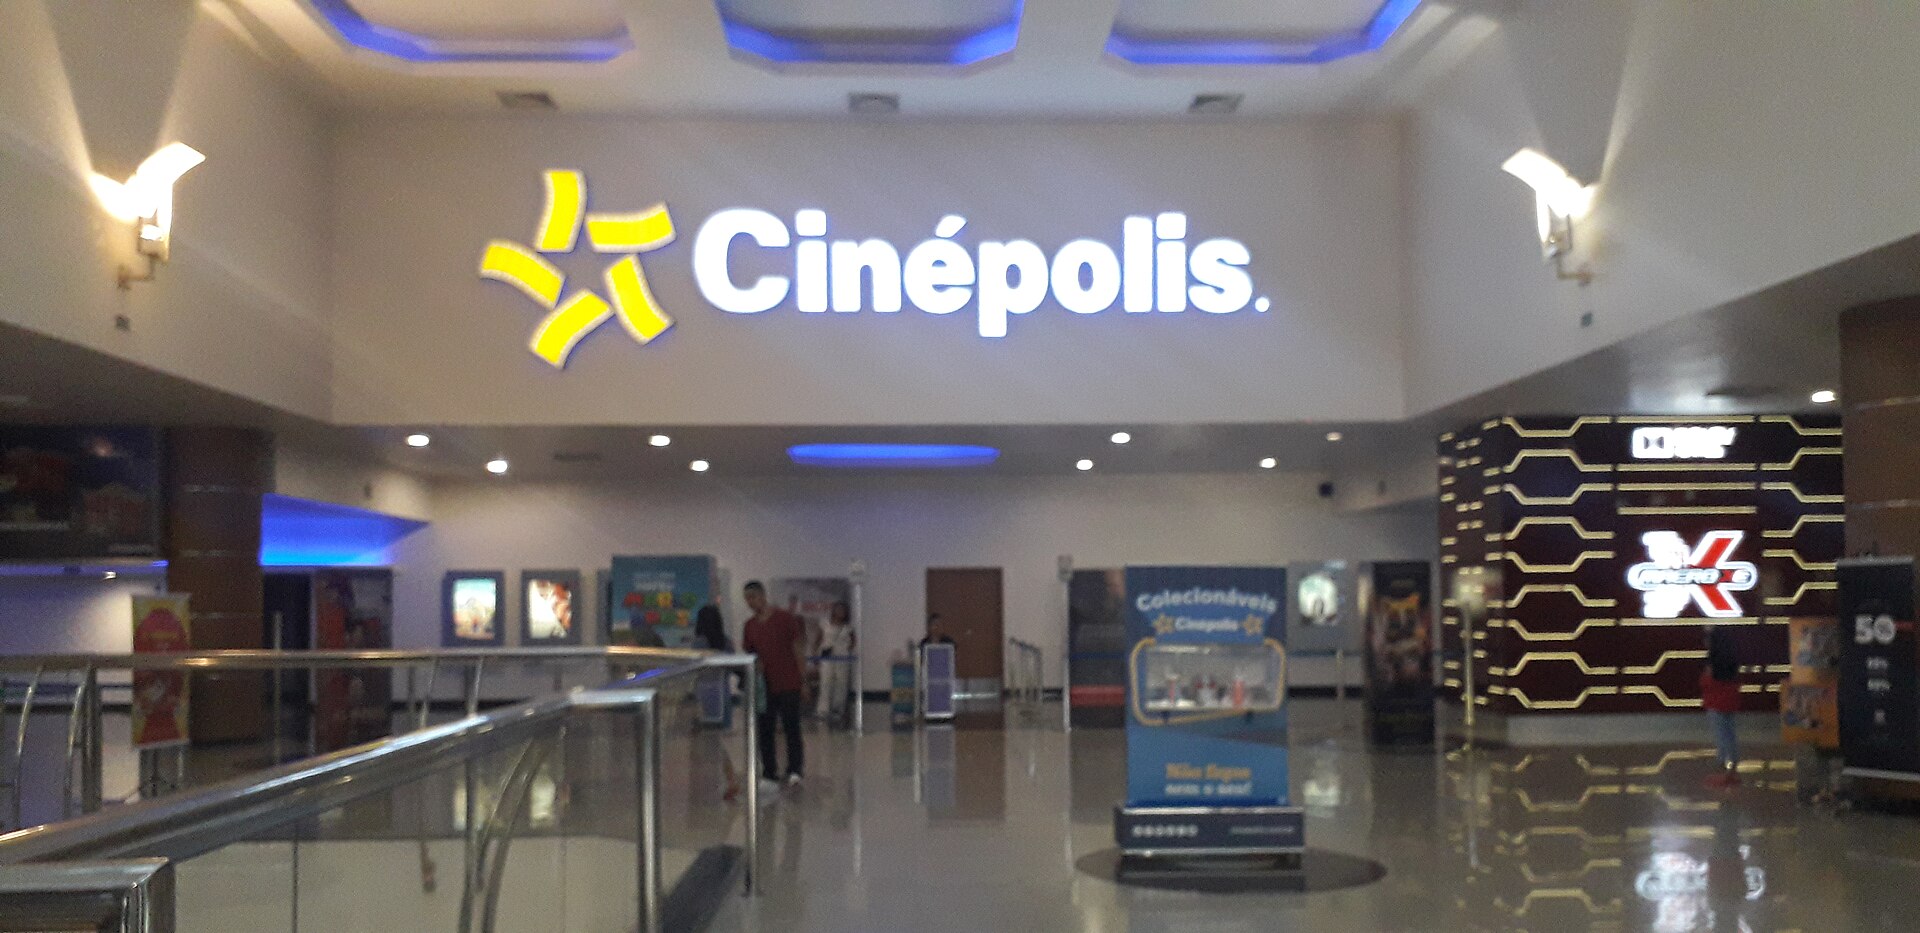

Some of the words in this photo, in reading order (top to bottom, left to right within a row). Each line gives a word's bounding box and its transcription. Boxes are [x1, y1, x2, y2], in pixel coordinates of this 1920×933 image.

[693, 208, 1270, 338] Cinépolis.
[1136, 588, 1277, 615] Colecionáveis
[1854, 614, 1897, 645] 50
